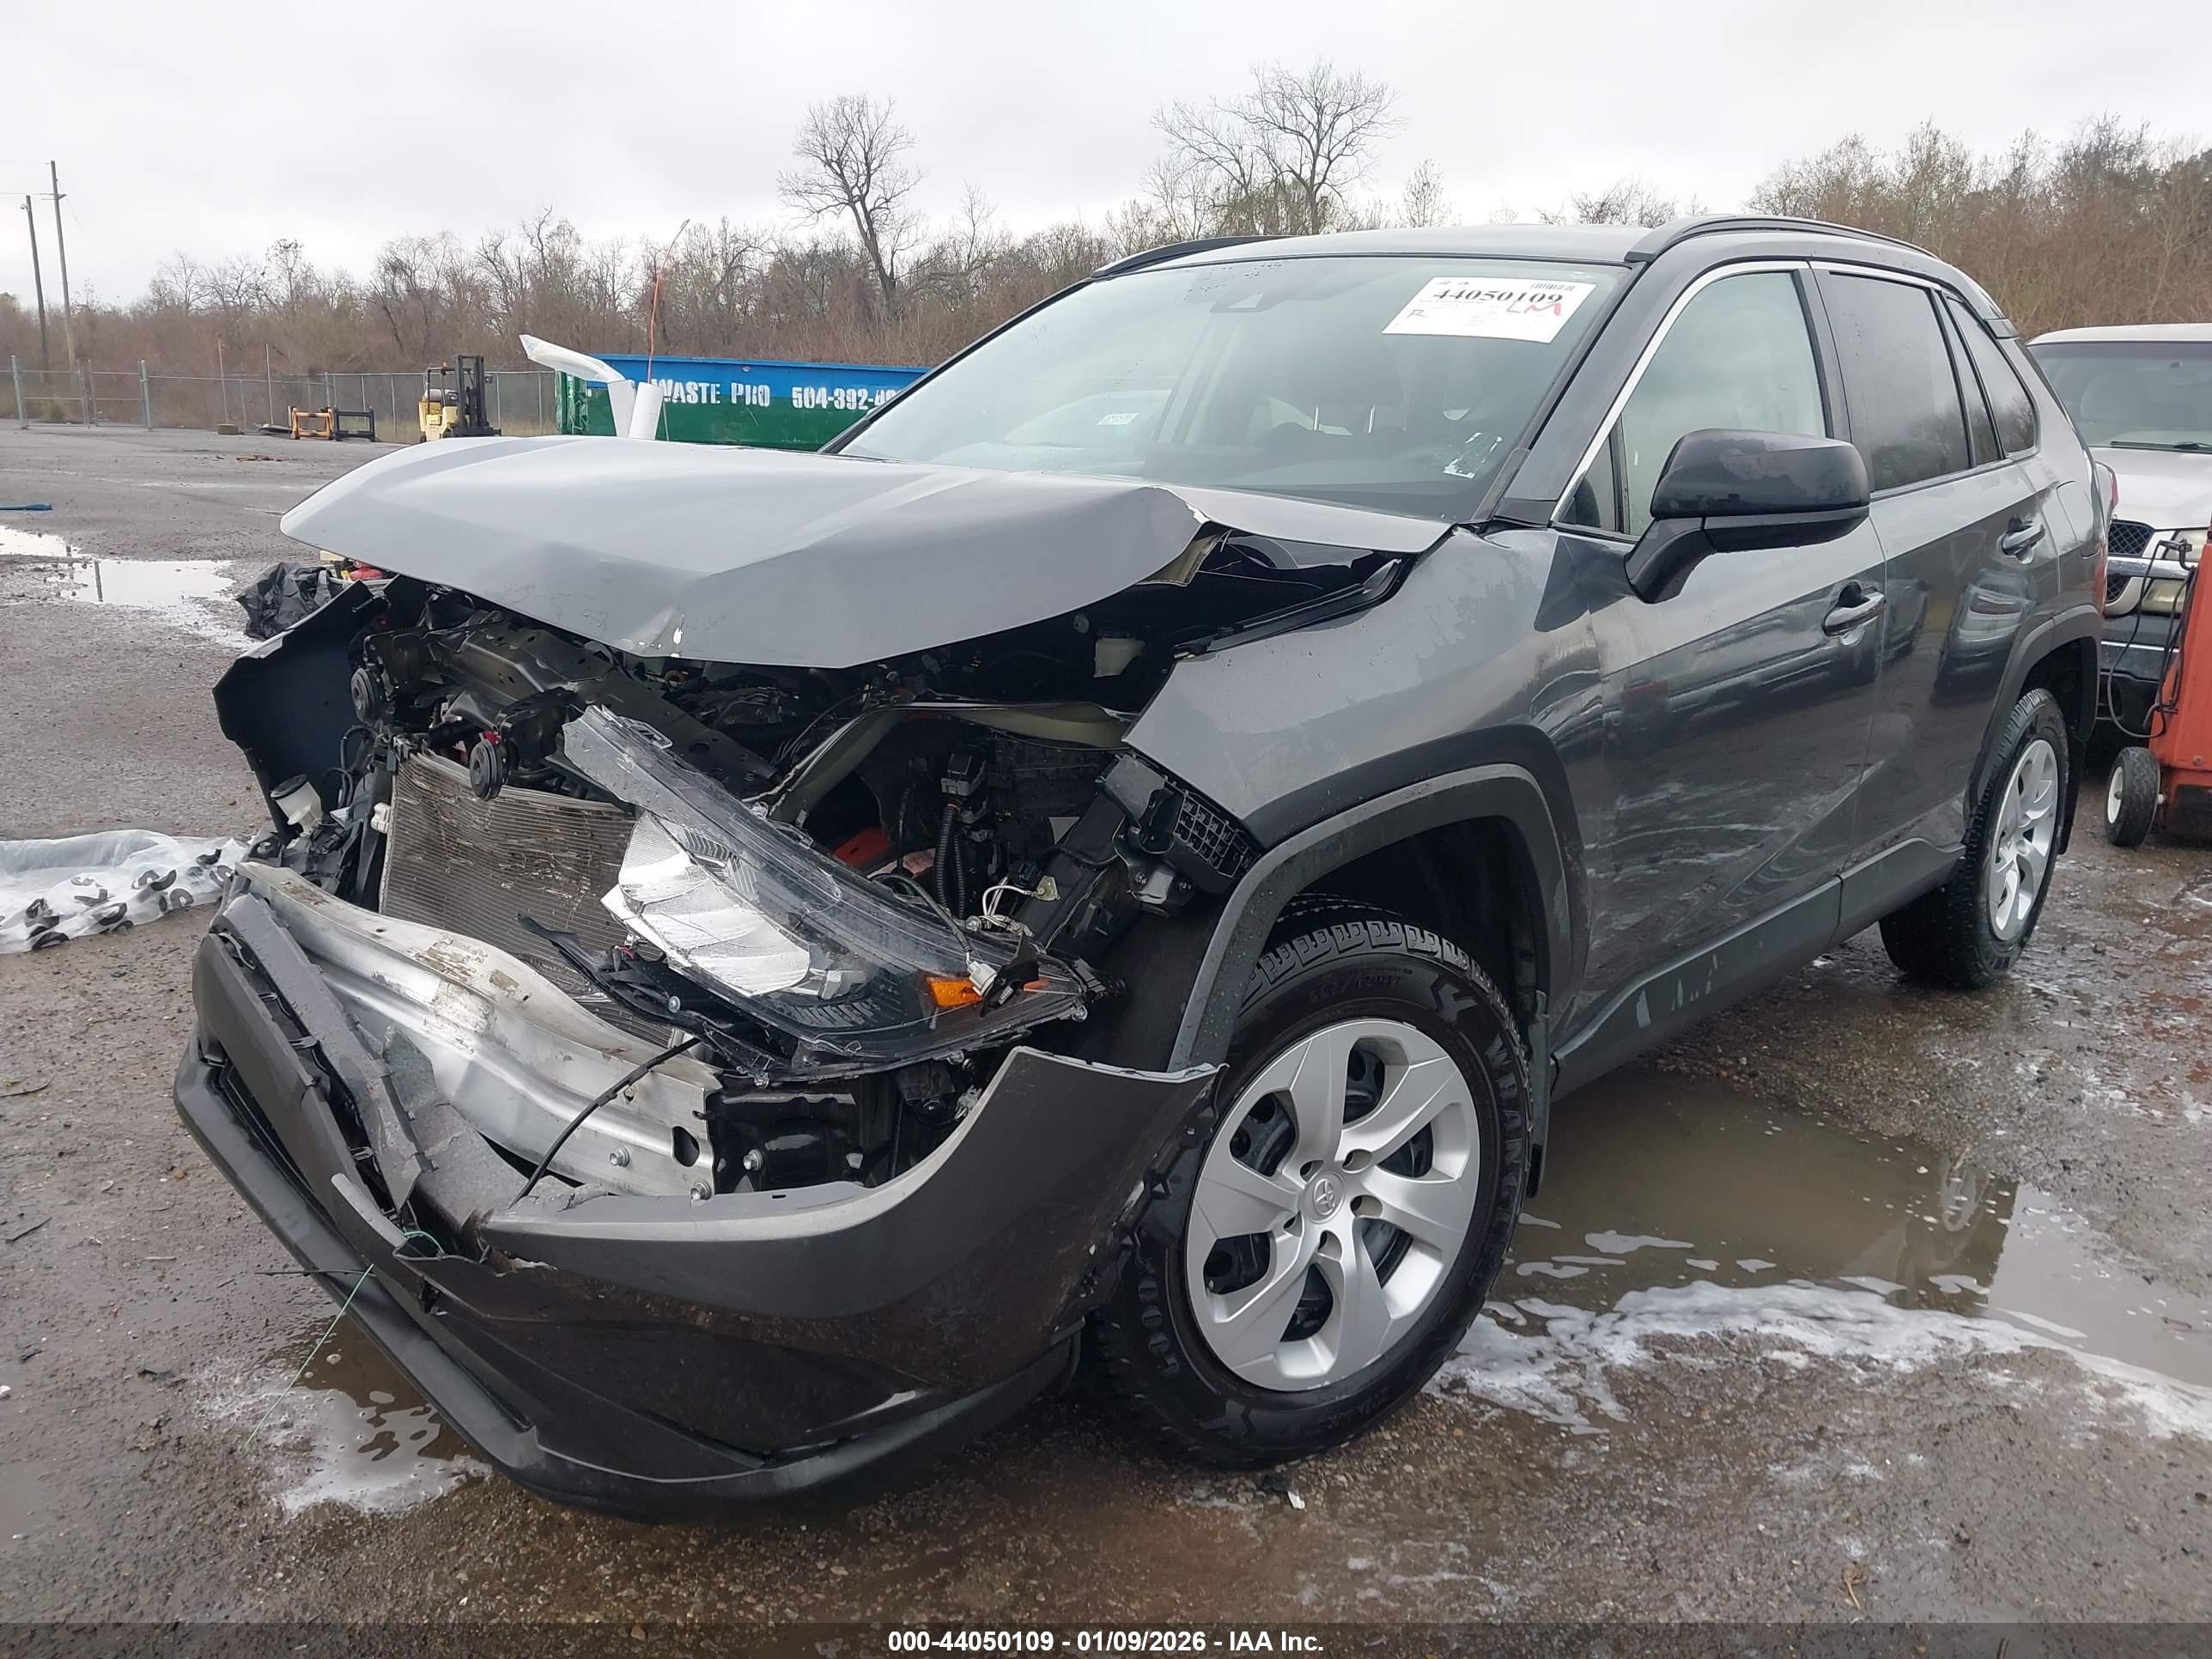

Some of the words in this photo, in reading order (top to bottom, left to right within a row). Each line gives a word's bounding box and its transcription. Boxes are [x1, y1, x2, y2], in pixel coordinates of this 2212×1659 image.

[1433, 289, 1563, 303] 44050109
[651, 379, 720, 404] WASTE
[731, 382, 770, 407] PRO
